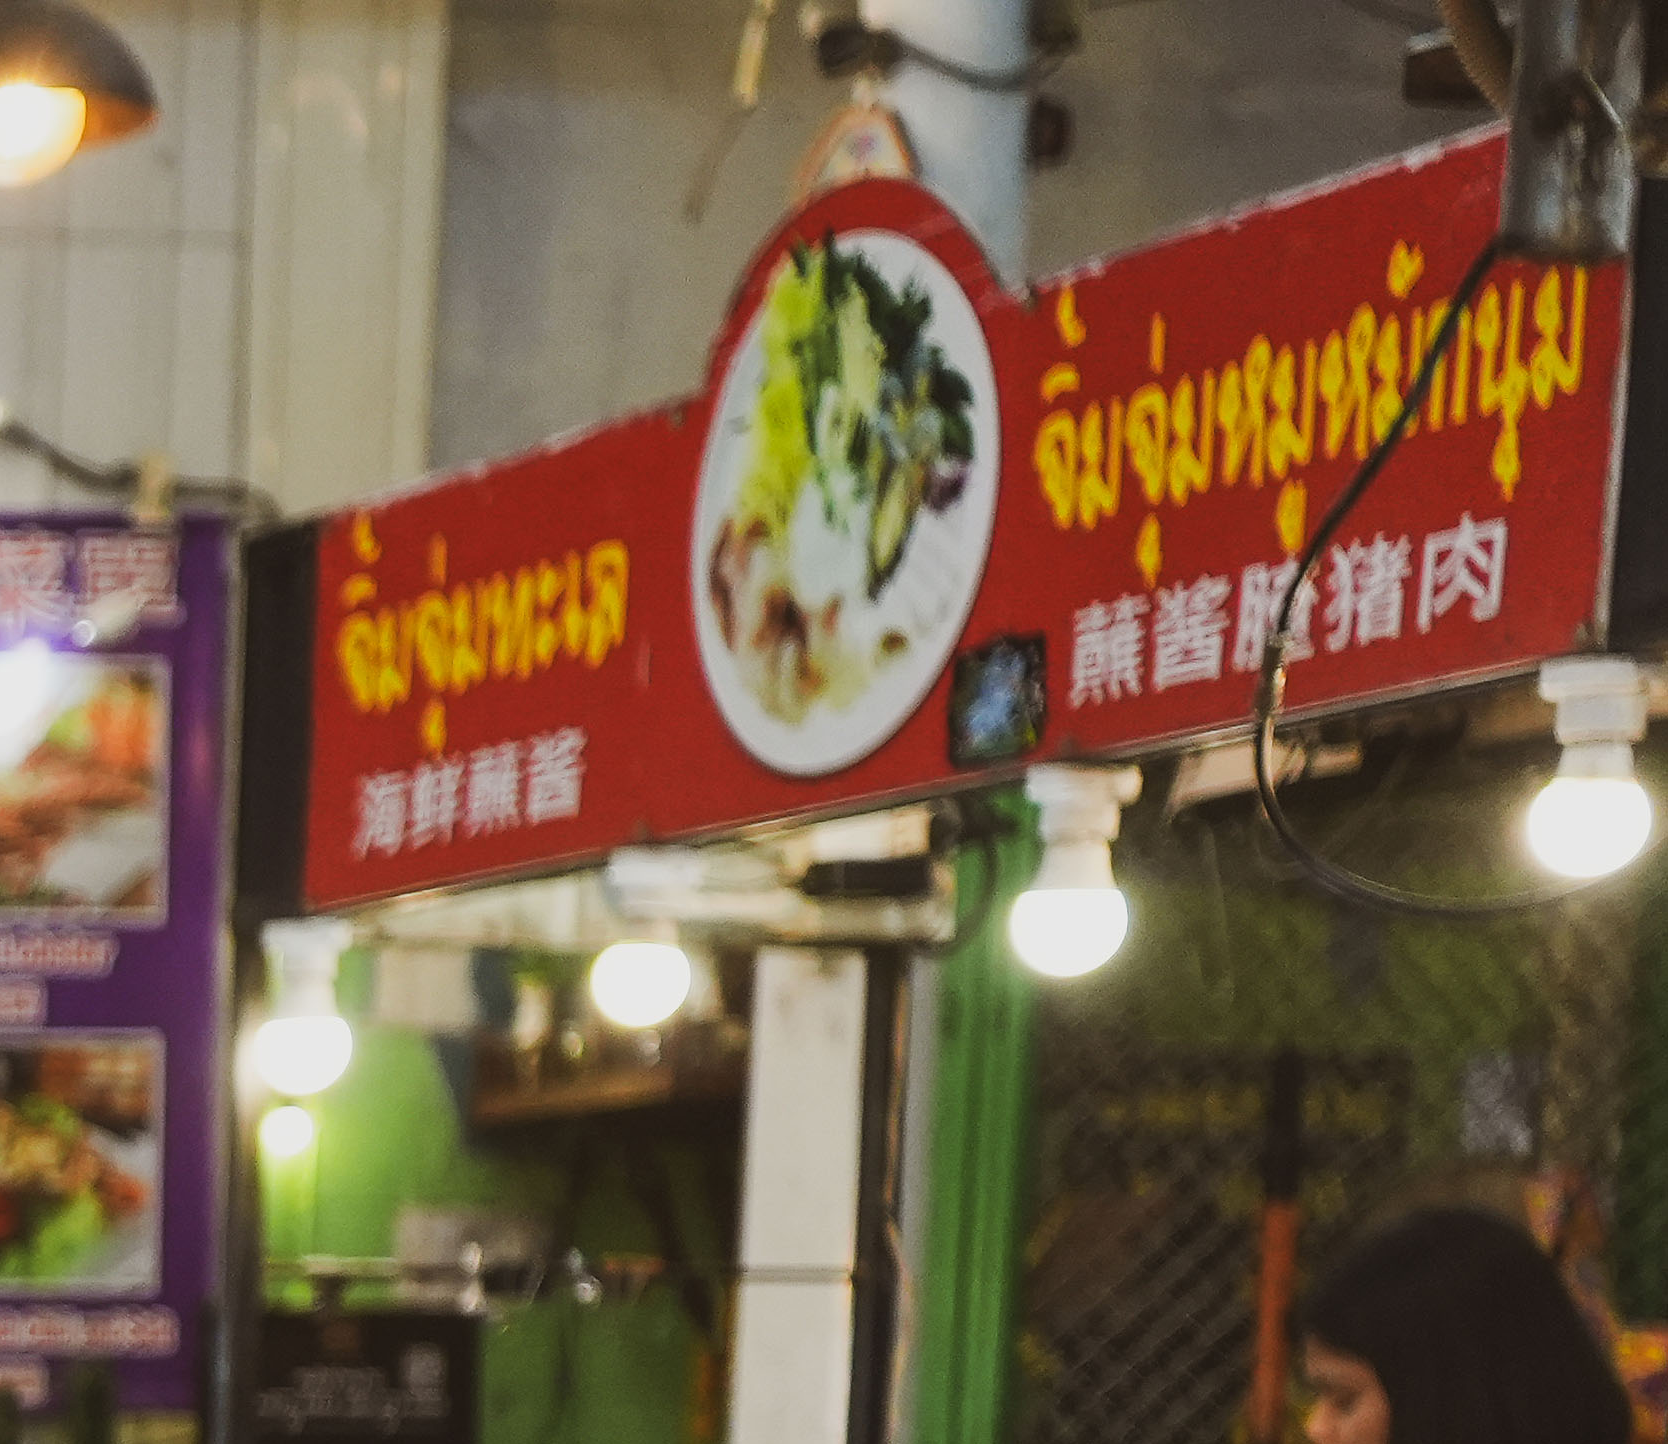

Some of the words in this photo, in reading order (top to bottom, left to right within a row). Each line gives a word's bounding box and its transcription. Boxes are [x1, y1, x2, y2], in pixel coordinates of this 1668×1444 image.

[337, 510, 630, 758] จิ้มจุ่มทะเล
